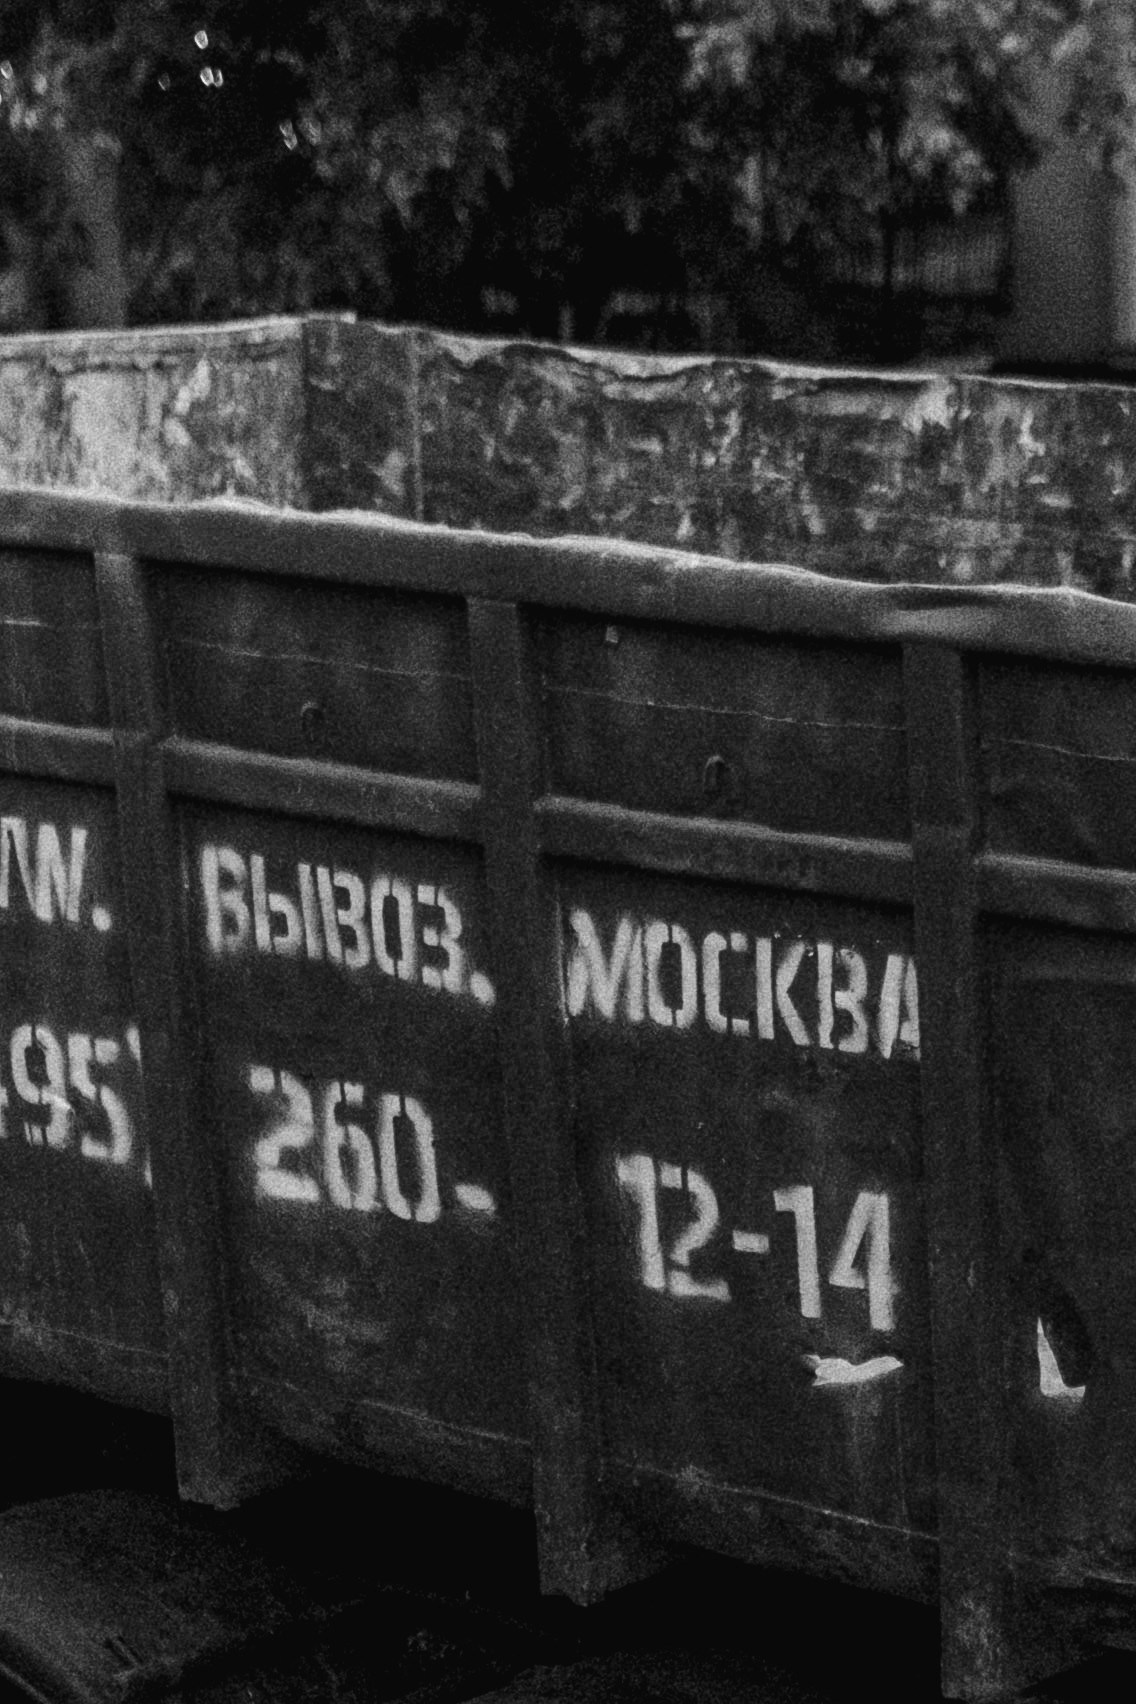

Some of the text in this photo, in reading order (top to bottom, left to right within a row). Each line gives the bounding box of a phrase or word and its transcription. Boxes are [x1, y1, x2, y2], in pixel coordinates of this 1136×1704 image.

[0, 816, 922, 1060] W. ВЫВОЗ. МОСКВА
[0, 1022, 153, 1190] 95
[615, 1154, 896, 1331] 12-14
